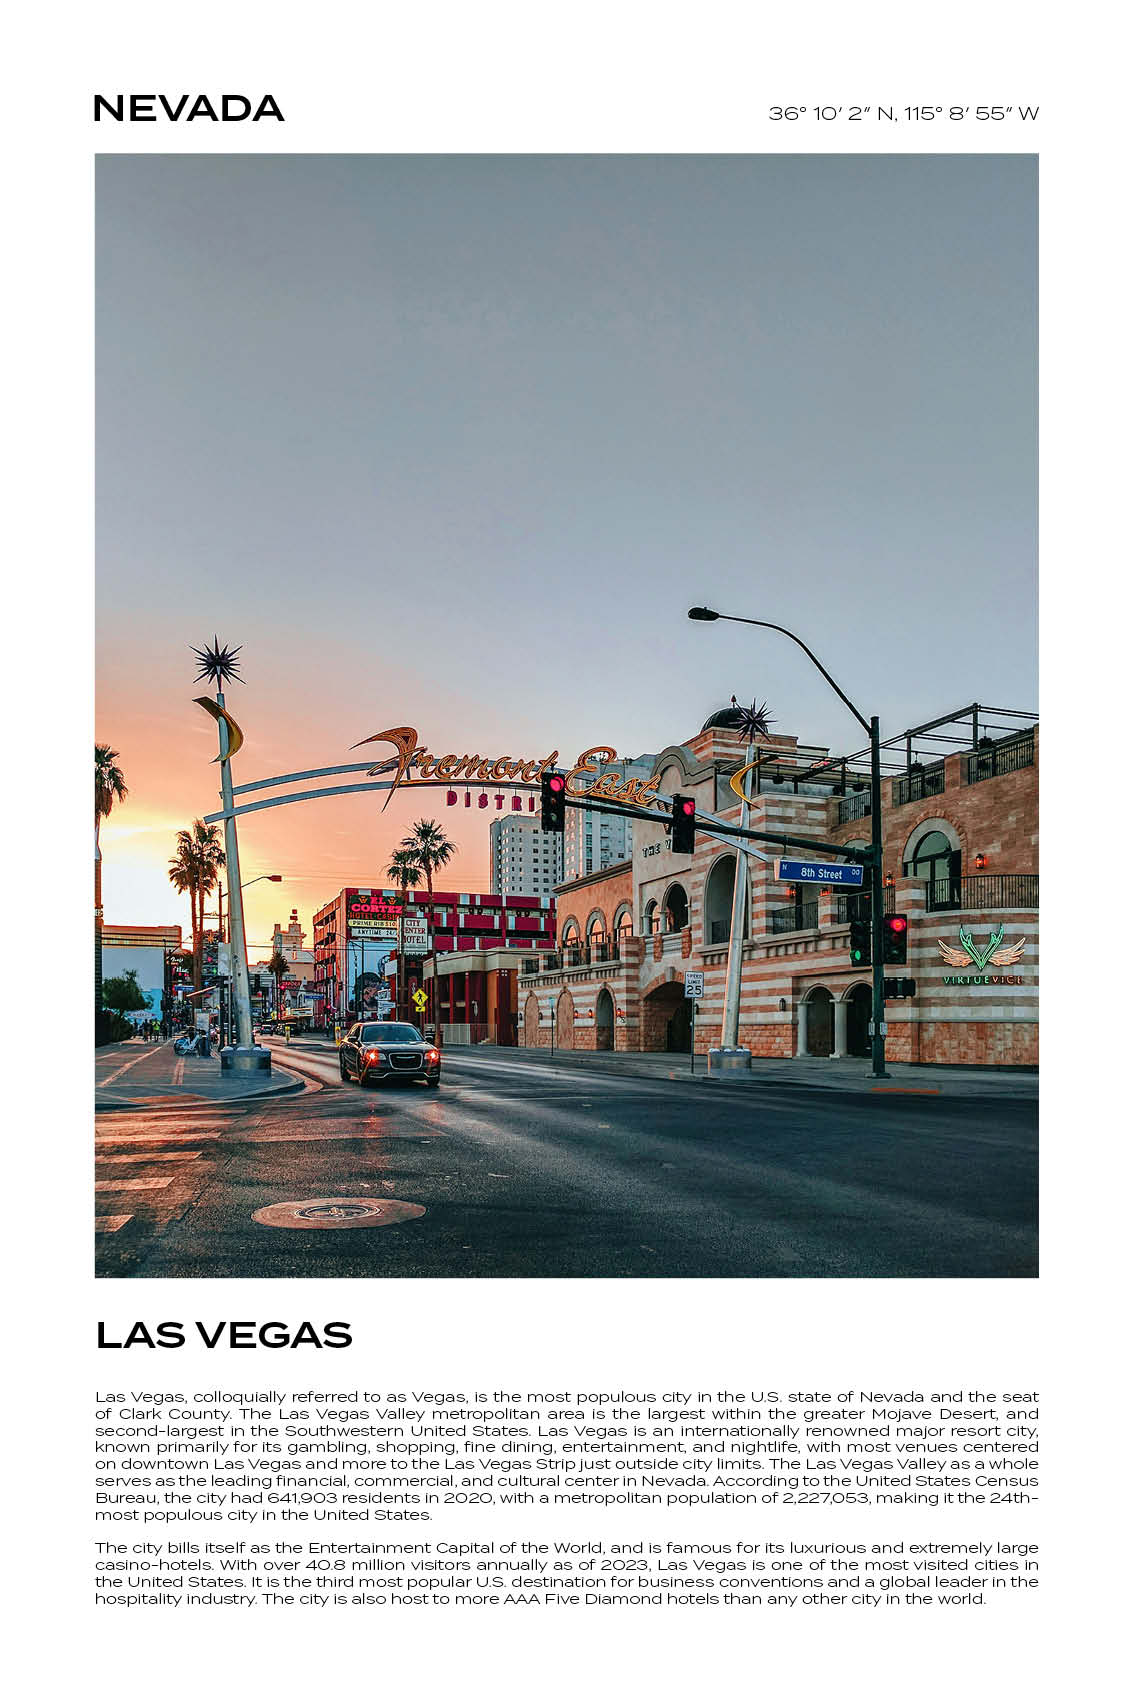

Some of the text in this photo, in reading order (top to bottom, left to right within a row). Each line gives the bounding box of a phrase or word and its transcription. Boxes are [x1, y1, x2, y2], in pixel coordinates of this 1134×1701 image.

[349, 727, 662, 812] Fremont East
[447, 789, 536, 813] DISTRI
[642, 842, 661, 858] THE
[801, 867, 815, 878] 8th
[818, 868, 843, 880] Street
[369, 897, 386, 905] EL
[351, 904, 403, 913] CORTEZ
[404, 927, 426, 935] ENTER
[686, 985, 702, 996] 25
